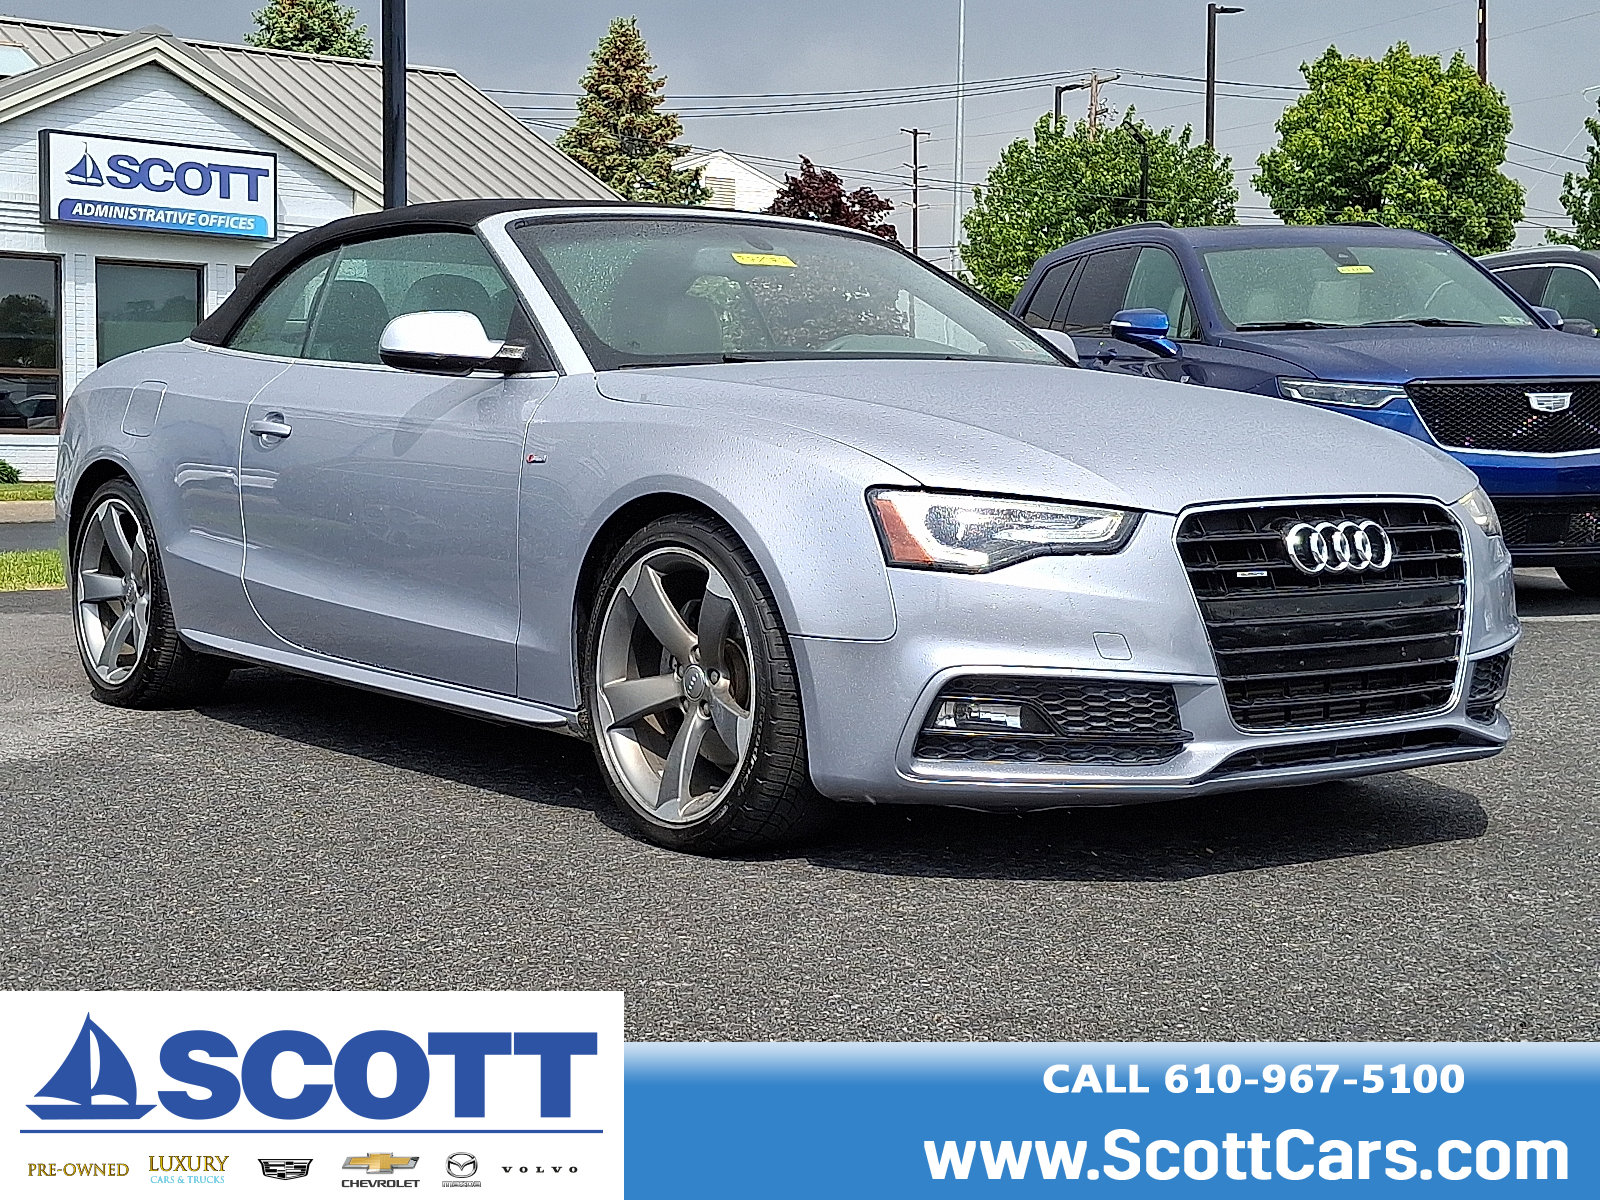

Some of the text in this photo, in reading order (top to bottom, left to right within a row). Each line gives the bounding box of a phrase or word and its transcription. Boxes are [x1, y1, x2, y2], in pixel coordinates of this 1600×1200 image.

[106, 154, 270, 202] SCOTT
[71, 202, 256, 231] ADMINISTRATIVE OFFICES
